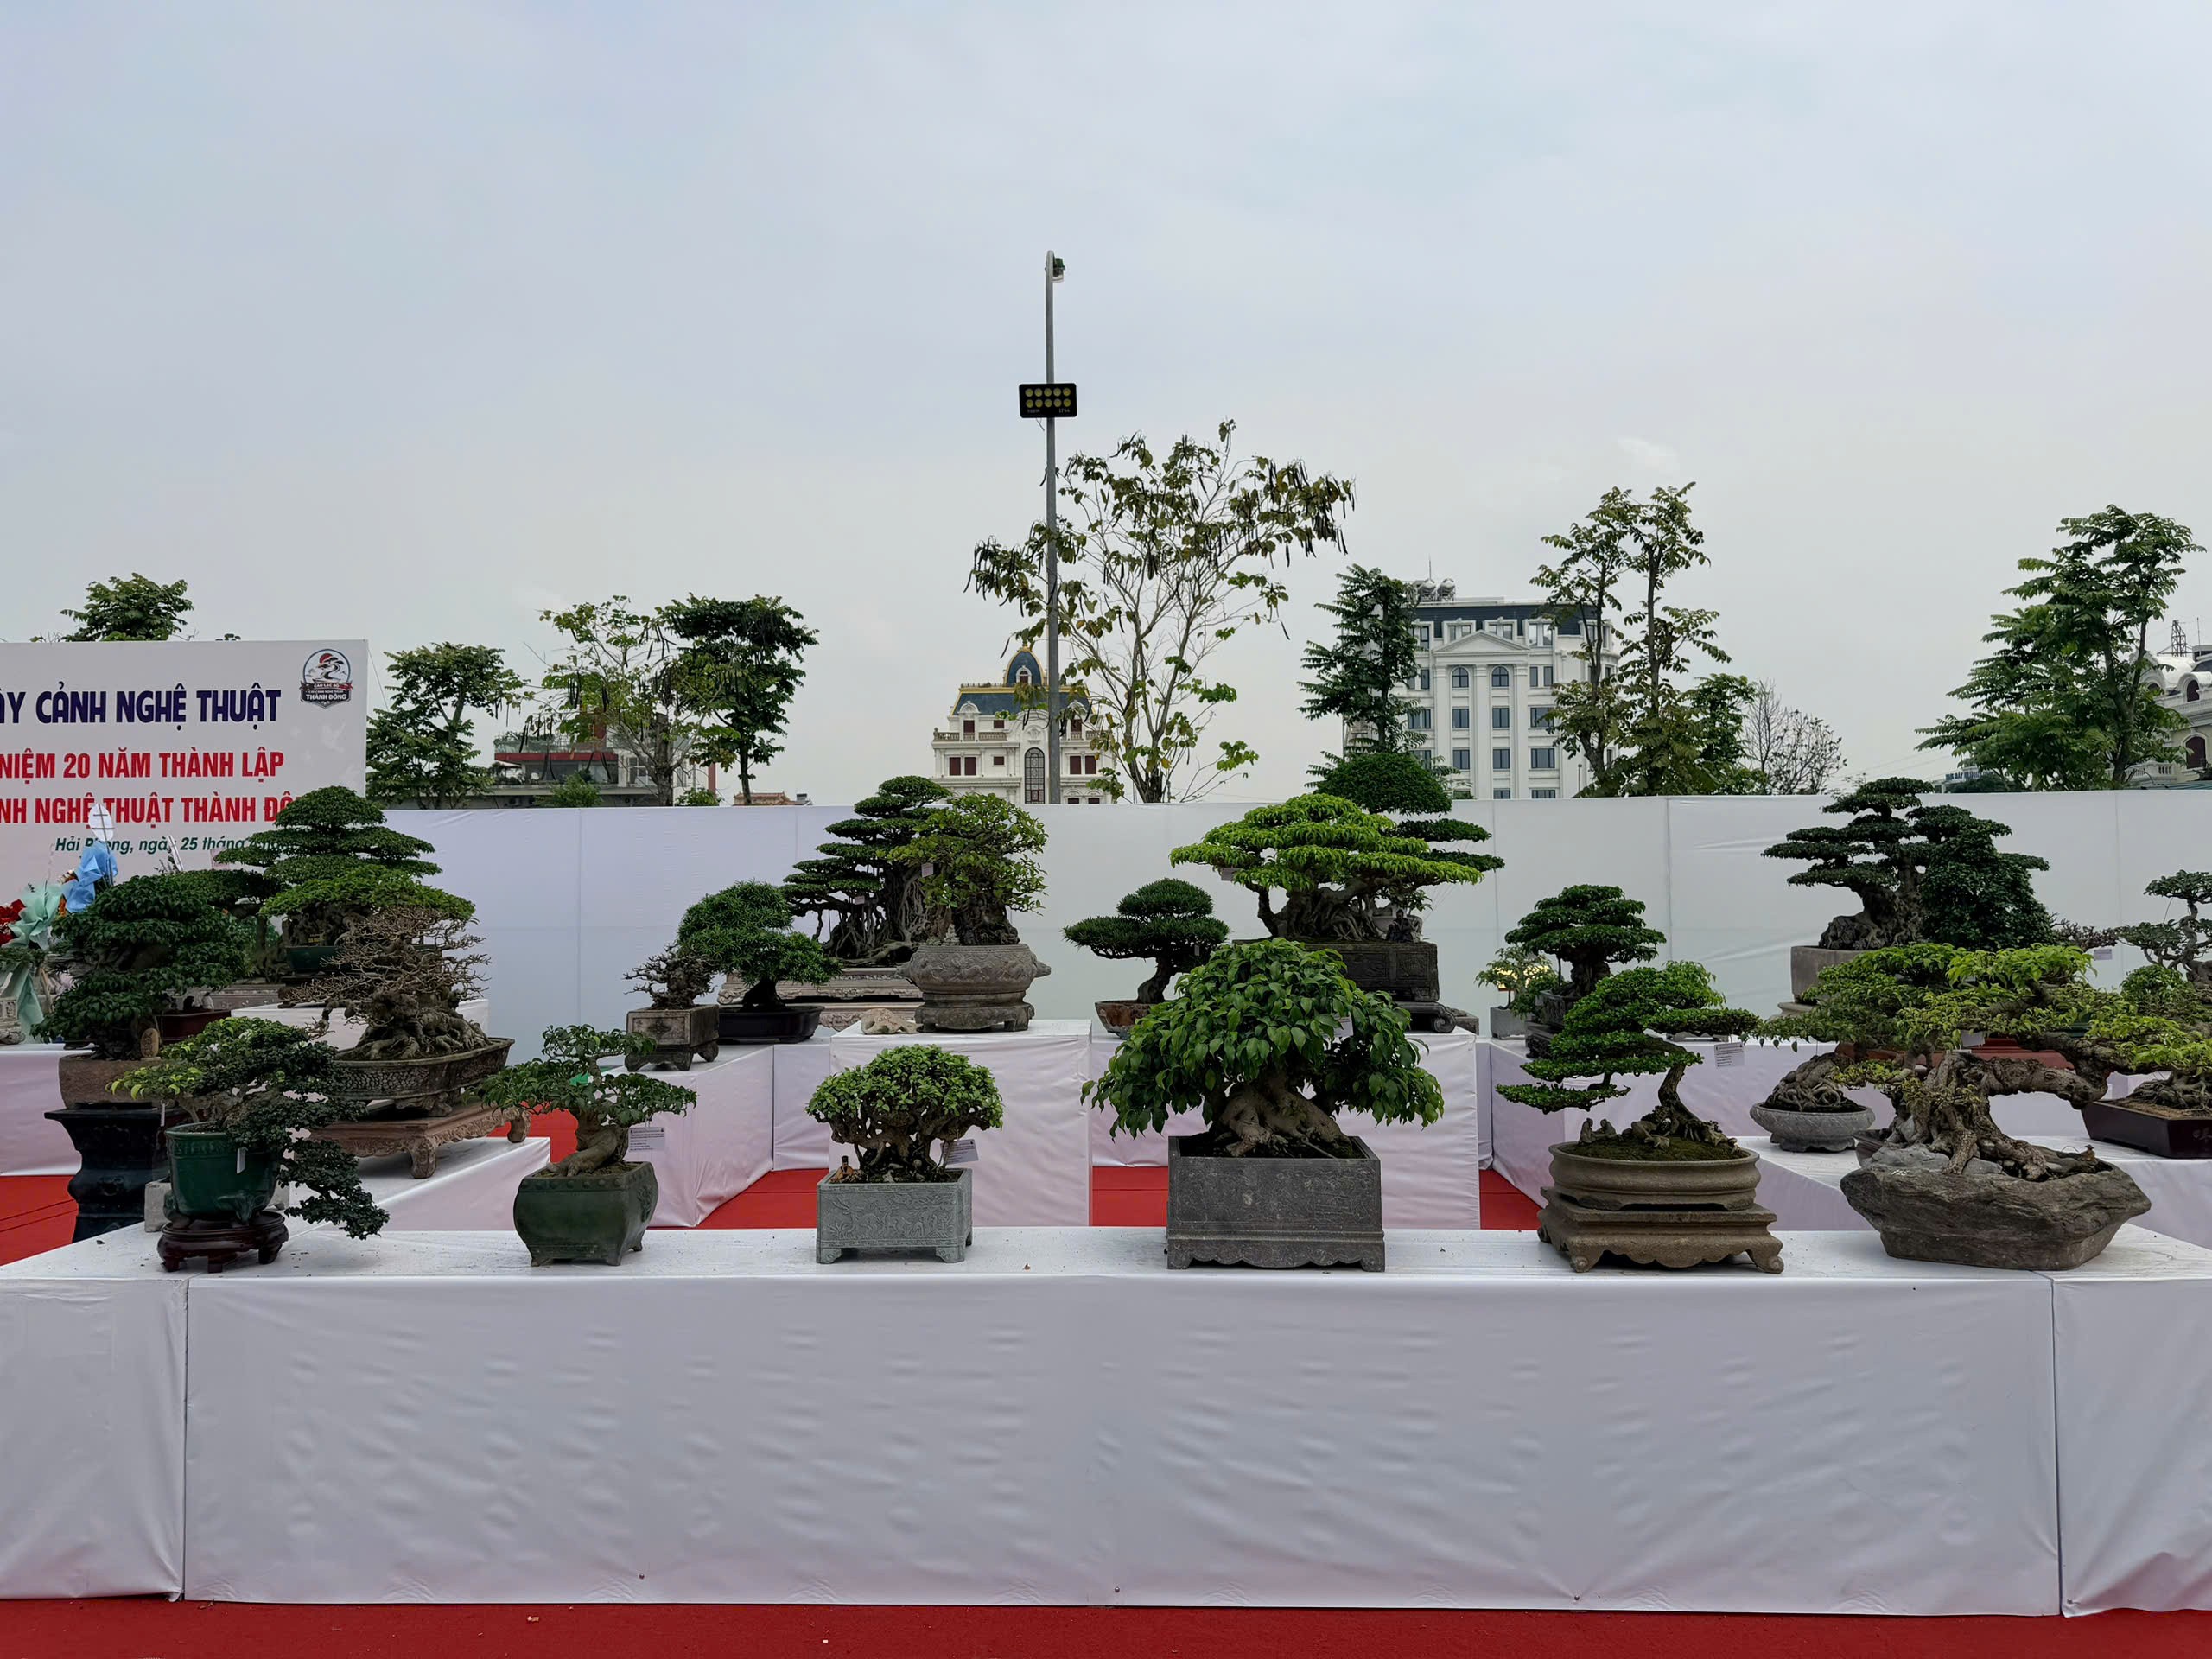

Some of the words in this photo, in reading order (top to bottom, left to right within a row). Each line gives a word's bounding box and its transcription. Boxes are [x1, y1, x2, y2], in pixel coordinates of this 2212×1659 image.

[0, 689, 26, 724] Y
[35, 681, 106, 724] CẢNH
[116, 683, 187, 731] NGHỆ
[196, 682, 282, 730] THUẬT
[0, 747, 55, 785] NIỆM
[63, 753, 91, 779] 20
[98, 747, 151, 779] NĂM
[159, 747, 234, 778] THÀNH
[242, 746, 284, 783] LẬP
[35, 792, 95, 829] NGHỆ
[103, 791, 174, 829] THUẬT
[181, 791, 256, 823] THÀNH
[55, 836, 81, 851] Hải
[180, 837, 198, 850] 25
